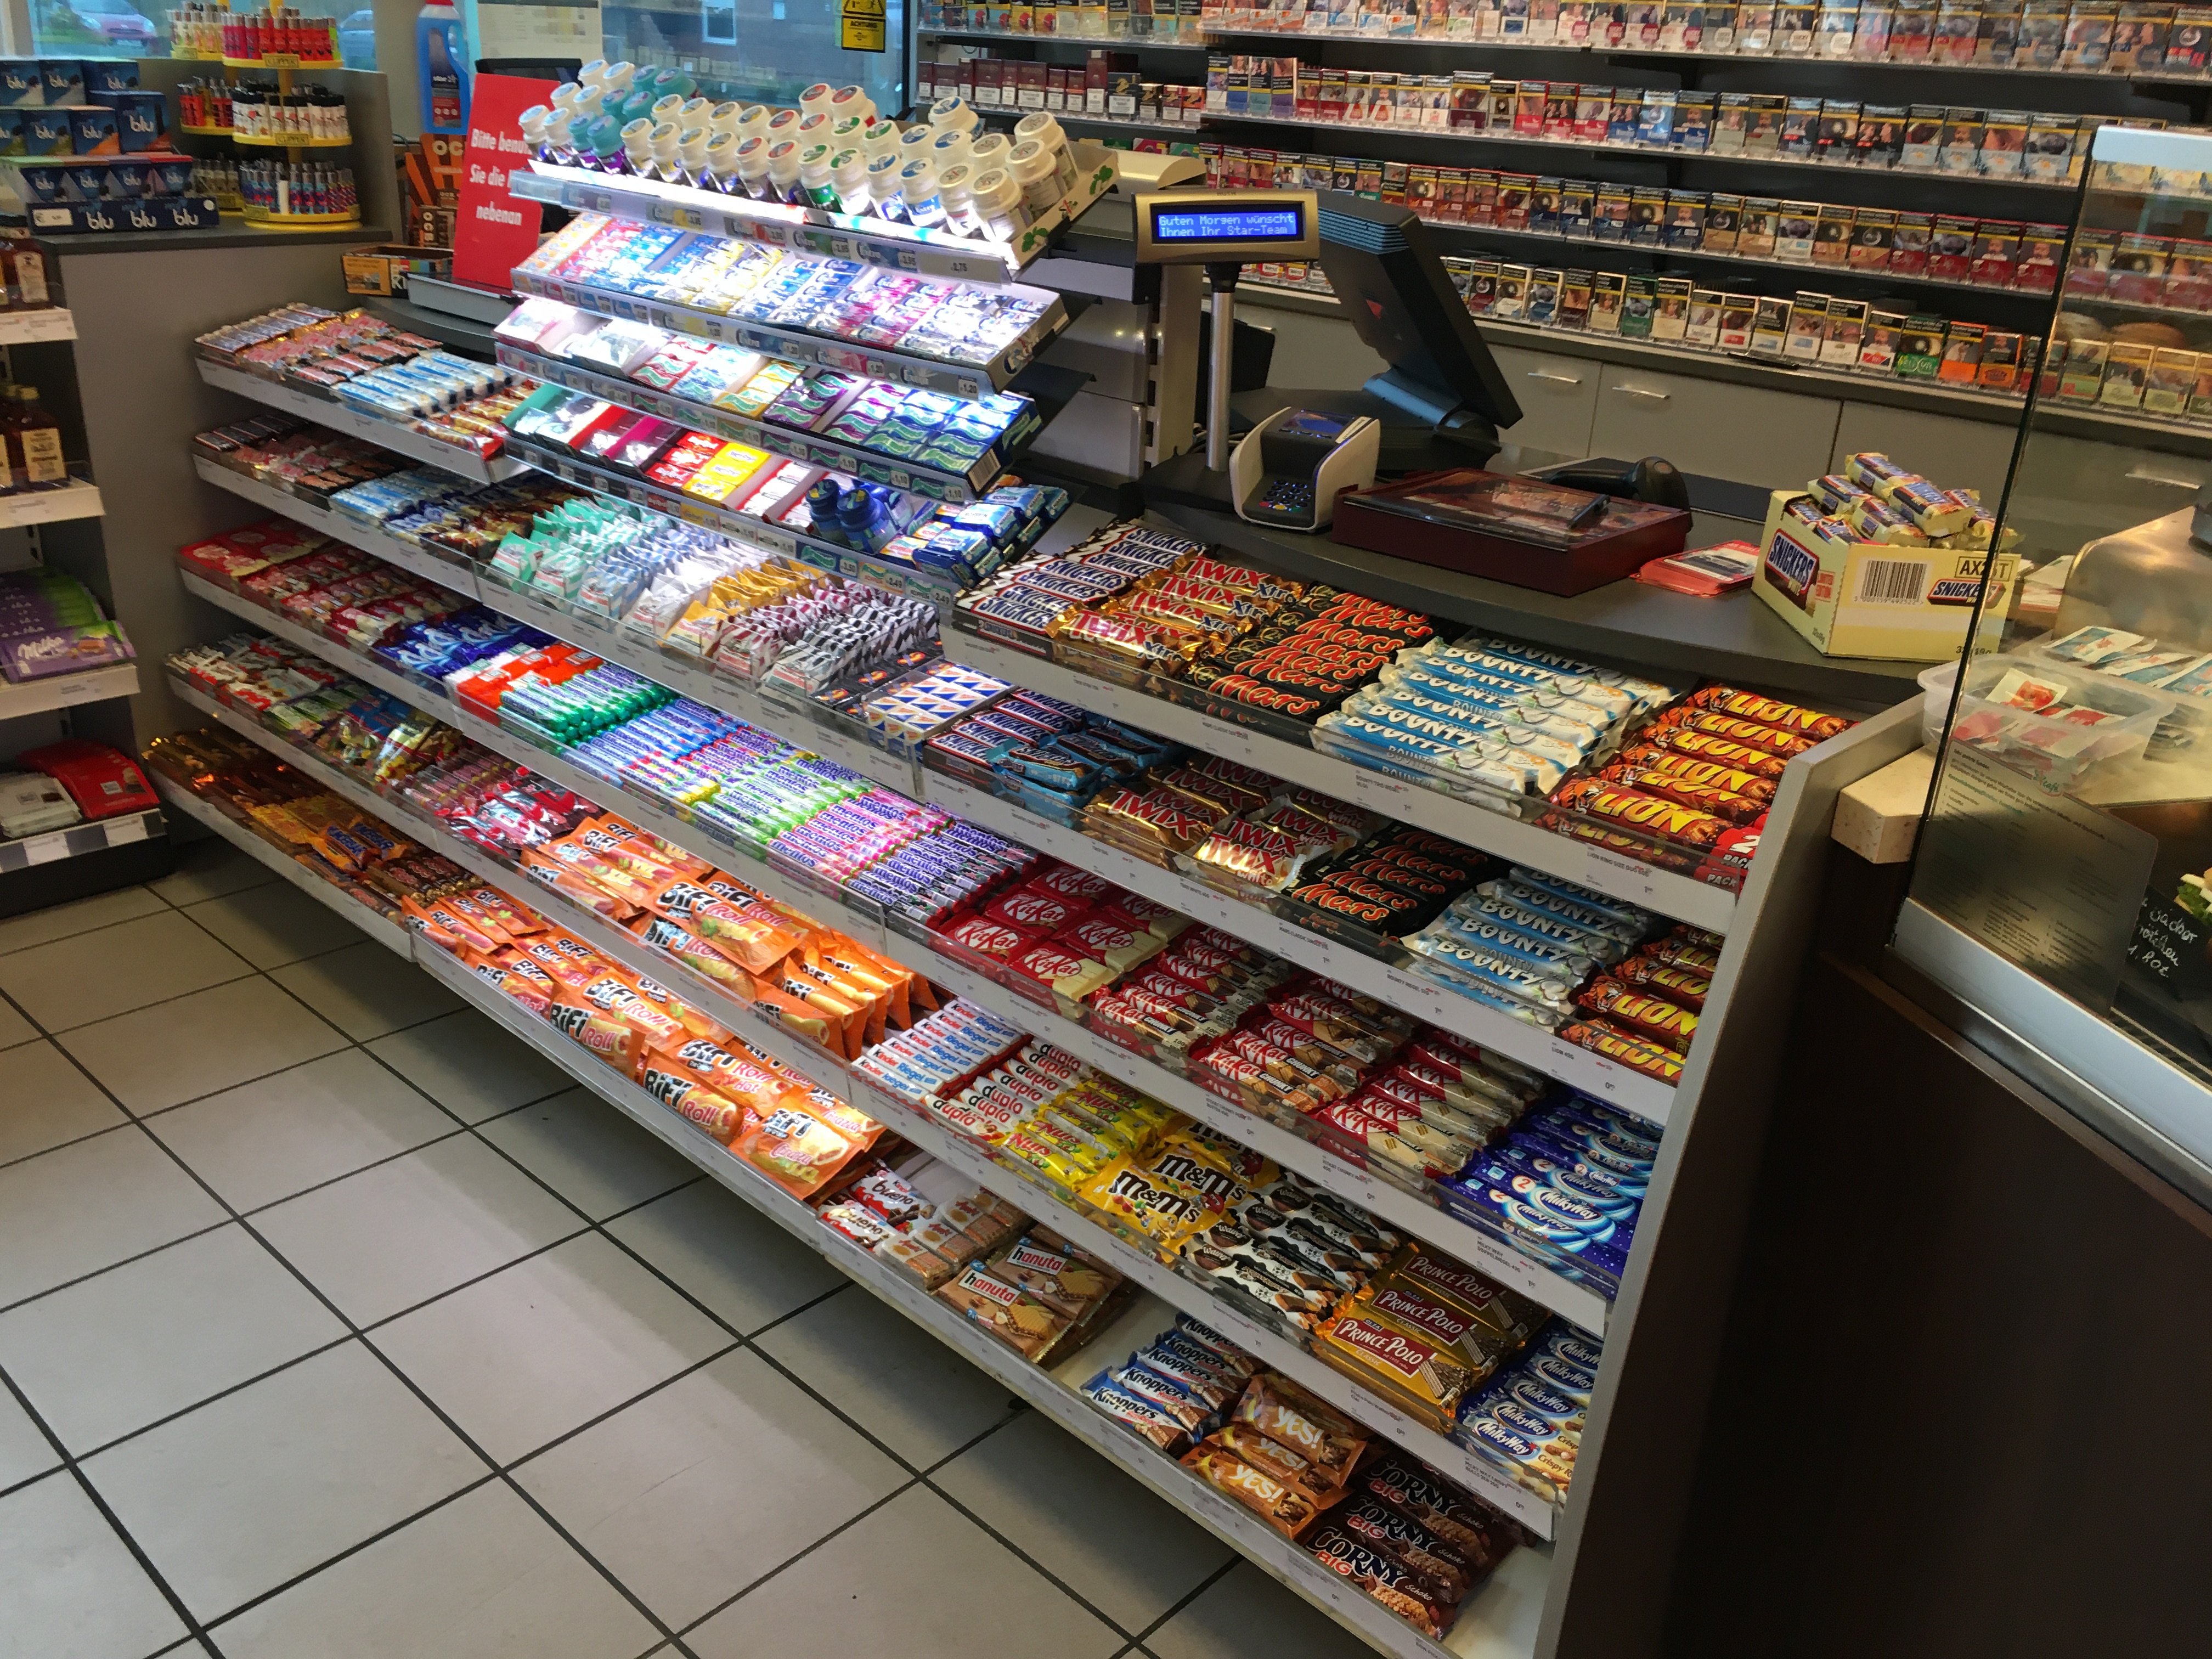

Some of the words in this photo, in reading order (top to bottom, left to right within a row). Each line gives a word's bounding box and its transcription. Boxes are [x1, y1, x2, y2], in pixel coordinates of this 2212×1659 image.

[36, 125, 55, 139] blu
[83, 125, 103, 138] blu
[129, 116, 154, 132] blu
[471, 128, 496, 150] Bitte
[469, 163, 486, 184] Sie
[488, 166, 505, 187] die
[86, 210, 114, 230] blu
[130, 208, 156, 228] blu
[173, 208, 199, 226] blu
[476, 201, 522, 225] nebenan
[1159, 215, 1193, 227] Guten
[1199, 214, 1241, 225] Morgen
[1246, 212, 1295, 224] wünscht
[1161, 227, 1195, 237] Ihnen
[1201, 225, 1220, 236] Ihr
[1227, 225, 1288, 236] Star-Team
[1045, 558, 1131, 588] SNICKERS
[1768, 534, 1814, 588] SNICKERS
[1018, 571, 1110, 600] SNICKERS
[1068, 609, 1154, 645] TWIX
[1295, 618, 1406, 653] Mars
[18, 635, 65, 661] Milka
[1279, 634, 1390, 670] Mars
[1444, 646, 1553, 681] BOUNTY
[1207, 674, 1320, 715] Mars
[1369, 703, 1483, 745] BOUNTY
[1727, 694, 1829, 730] LION
[1700, 713, 1796, 747] LION
[1673, 731, 1773, 765] LION
[1655, 755, 1759, 792] LION
[817, 812, 868, 837] mentos
[830, 803, 878, 831] mentos
[1108, 790, 1198, 840] TWIX
[1592, 792, 1702, 834] LION
[770, 839, 818, 867] mentos
[796, 826, 845, 852] mentos
[1322, 871, 1419, 910] Mars
[1350, 858, 1447, 894] Mars
[708, 880, 762, 909] BiFi
[1002, 894, 1066, 923] KitKat
[1290, 883, 1390, 922] Mars
[1077, 920, 1136, 949] KitKat
[1479, 898, 1588, 943] BOUNTY
[557, 938, 594, 958] BiFi
[953, 921, 1020, 951] KitKat
[1459, 918, 1572, 962] BOUNTY
[1023, 949, 1082, 978] KitKat
[1436, 940, 1547, 986] BOUNTY
[550, 1003, 593, 1040] BiFi
[581, 1025, 616, 1052] Roll
[624, 1002, 669, 1028] Roll
[974, 1017, 1003, 1035] Riegel
[1142, 1014, 1177, 1036] CHUNKY
[945, 1035, 974, 1054] Riegel
[961, 1026, 989, 1044] Riegel
[912, 1053, 940, 1071] Riegel
[932, 1045, 960, 1064] Riegel
[1028, 1051, 1071, 1080] duplo
[1285, 1056, 1320, 1079] CHUNKY
[896, 1062, 924, 1081] Riegel
[1015, 1063, 1059, 1092] duplo
[1258, 1072, 1295, 1094] CHUNKY
[643, 1068, 694, 1107] BiFi
[680, 1101, 718, 1125] Roll
[735, 1080, 759, 1095] Hot
[982, 1085, 1024, 1115] duplo
[1000, 1075, 1043, 1103] duplo
[1075, 1091, 1122, 1113] Nuts
[932, 1097, 978, 1126] duplo
[1008, 1132, 1052, 1158] Nuts
[1032, 1120, 1082, 1145] Nuts
[871, 1180, 916, 1206] bueno
[1152, 1154, 1248, 1203] m&m's
[1520, 1176, 1531, 1192] 2
[1108, 1171, 1203, 1224] m&m's
[1538, 1189, 1603, 1221] MilkyWay
[1011, 1246, 1064, 1273] hanuta
[963, 1272, 1018, 1306] hanuta
[1412, 1255, 1462, 1283] PRINCE
[1453, 1272, 1493, 1301] POLO
[1364, 1318, 1382, 1331] OLZA
[1378, 1290, 1429, 1319] PRINCE
[1424, 1307, 1464, 1335] POLO
[1396, 1317, 1421, 1335] CLASSIC
[1167, 1338, 1226, 1370] Knoppers
[1336, 1321, 1387, 1348] PRINCE
[1381, 1337, 1425, 1365] POLO
[1148, 1348, 1212, 1380] Knoppers
[1355, 1348, 1381, 1368] CLASSIC
[1124, 1368, 1188, 1402] Knoppers
[1092, 1387, 1159, 1420] Knoppers
[1276, 1405, 1324, 1448] YES!
[1499, 1405, 1549, 1435] MilkyWay
[1480, 1421, 1530, 1454] MilkyWay
[1557, 1435, 1578, 1450] Crisp
[1259, 1438, 1307, 1471] YES!
[1537, 1453, 1565, 1472] Crispy
[1227, 1464, 1284, 1504] YES!
[1369, 1480, 1407, 1503] BIG
[1345, 1496, 1436, 1553] CORNY
[1347, 1515, 1385, 1539] BIG
[1457, 1512, 1485, 1530] Schoko
[1305, 1526, 1410, 1589] CORNY
[1315, 1550, 1353, 1576] BIG
[1437, 1548, 1466, 1565] Schoko
[1404, 1583, 1433, 1602] Schoko
